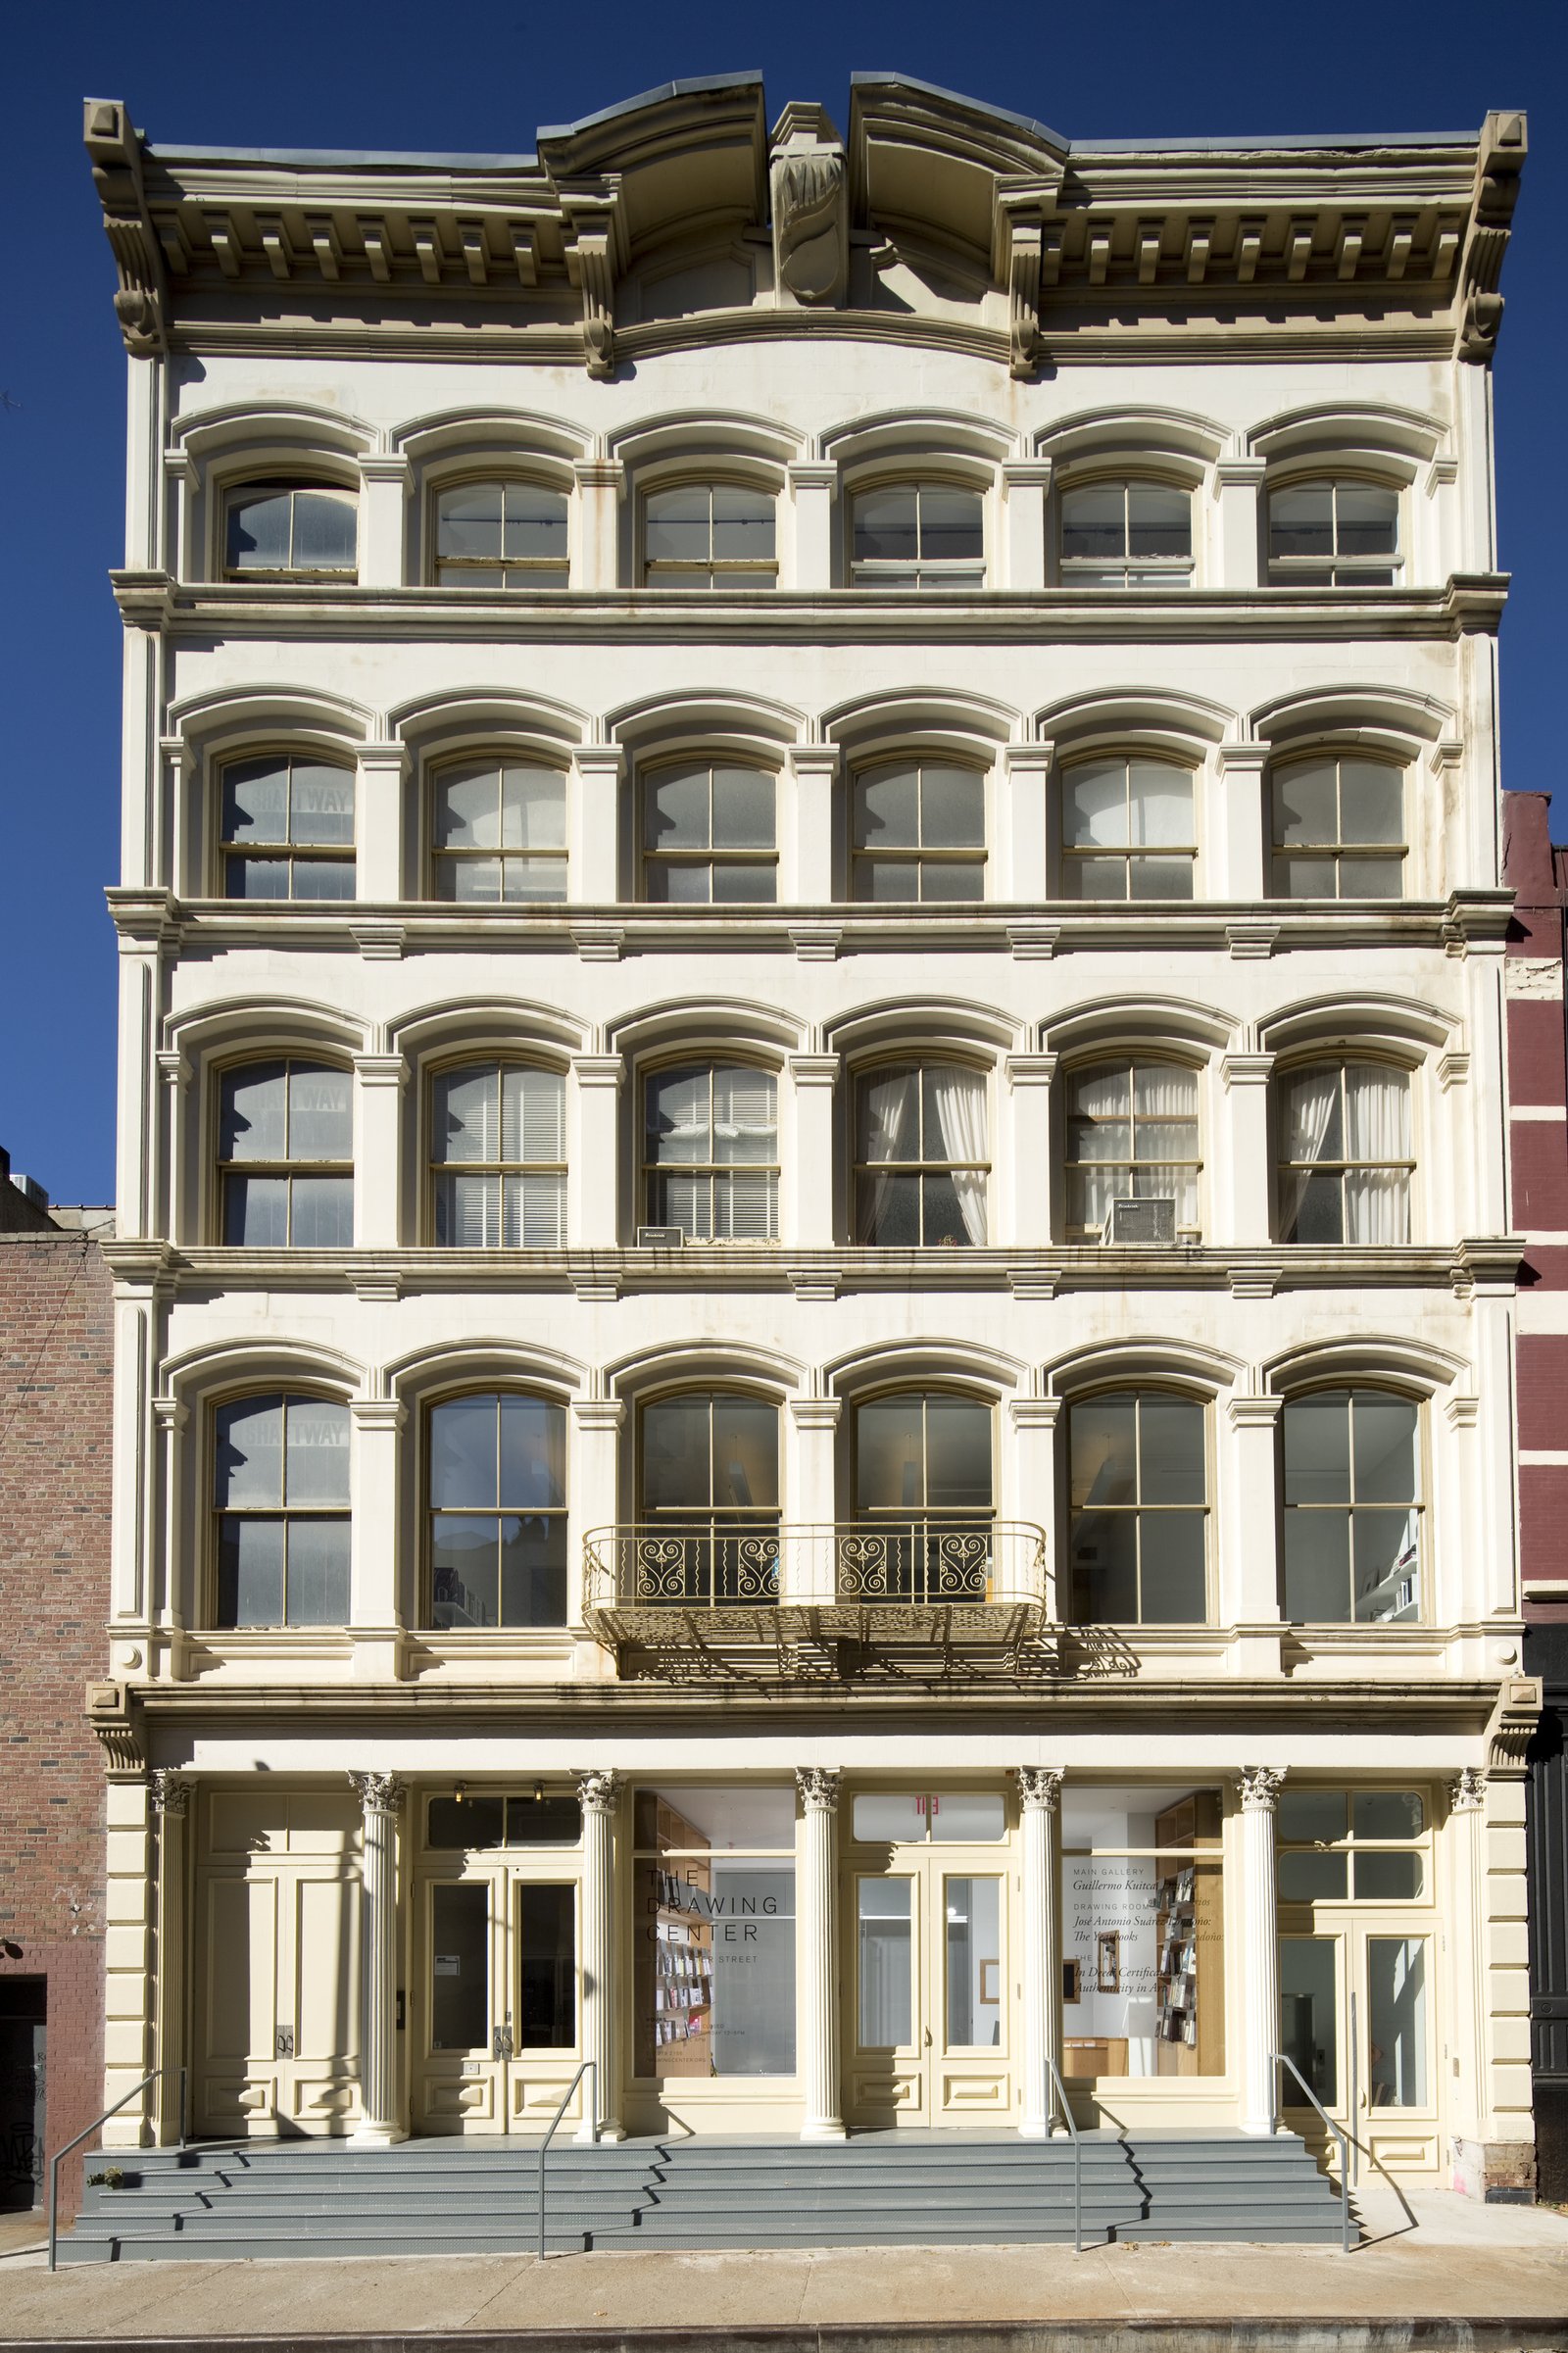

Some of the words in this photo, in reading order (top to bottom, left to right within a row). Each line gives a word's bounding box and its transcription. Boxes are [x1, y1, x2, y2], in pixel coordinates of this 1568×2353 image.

[251, 788, 348, 812] SHATWAY
[245, 1422, 344, 1446] SHATWAY
[646, 1869, 699, 1887] THE
[1072, 1879, 1122, 1890] Guillermo
[646, 1896, 778, 1915] DRAWING
[1073, 1915, 1093, 1928] José
[1093, 1916, 1132, 1927] Antonio
[1133, 1915, 1165, 1927] Suárez
[646, 1923, 759, 1942] CENTER
[1073, 1931, 1089, 1941] The
[717, 1955, 759, 1964] STREET
[1136, 1983, 1147, 1993] in
